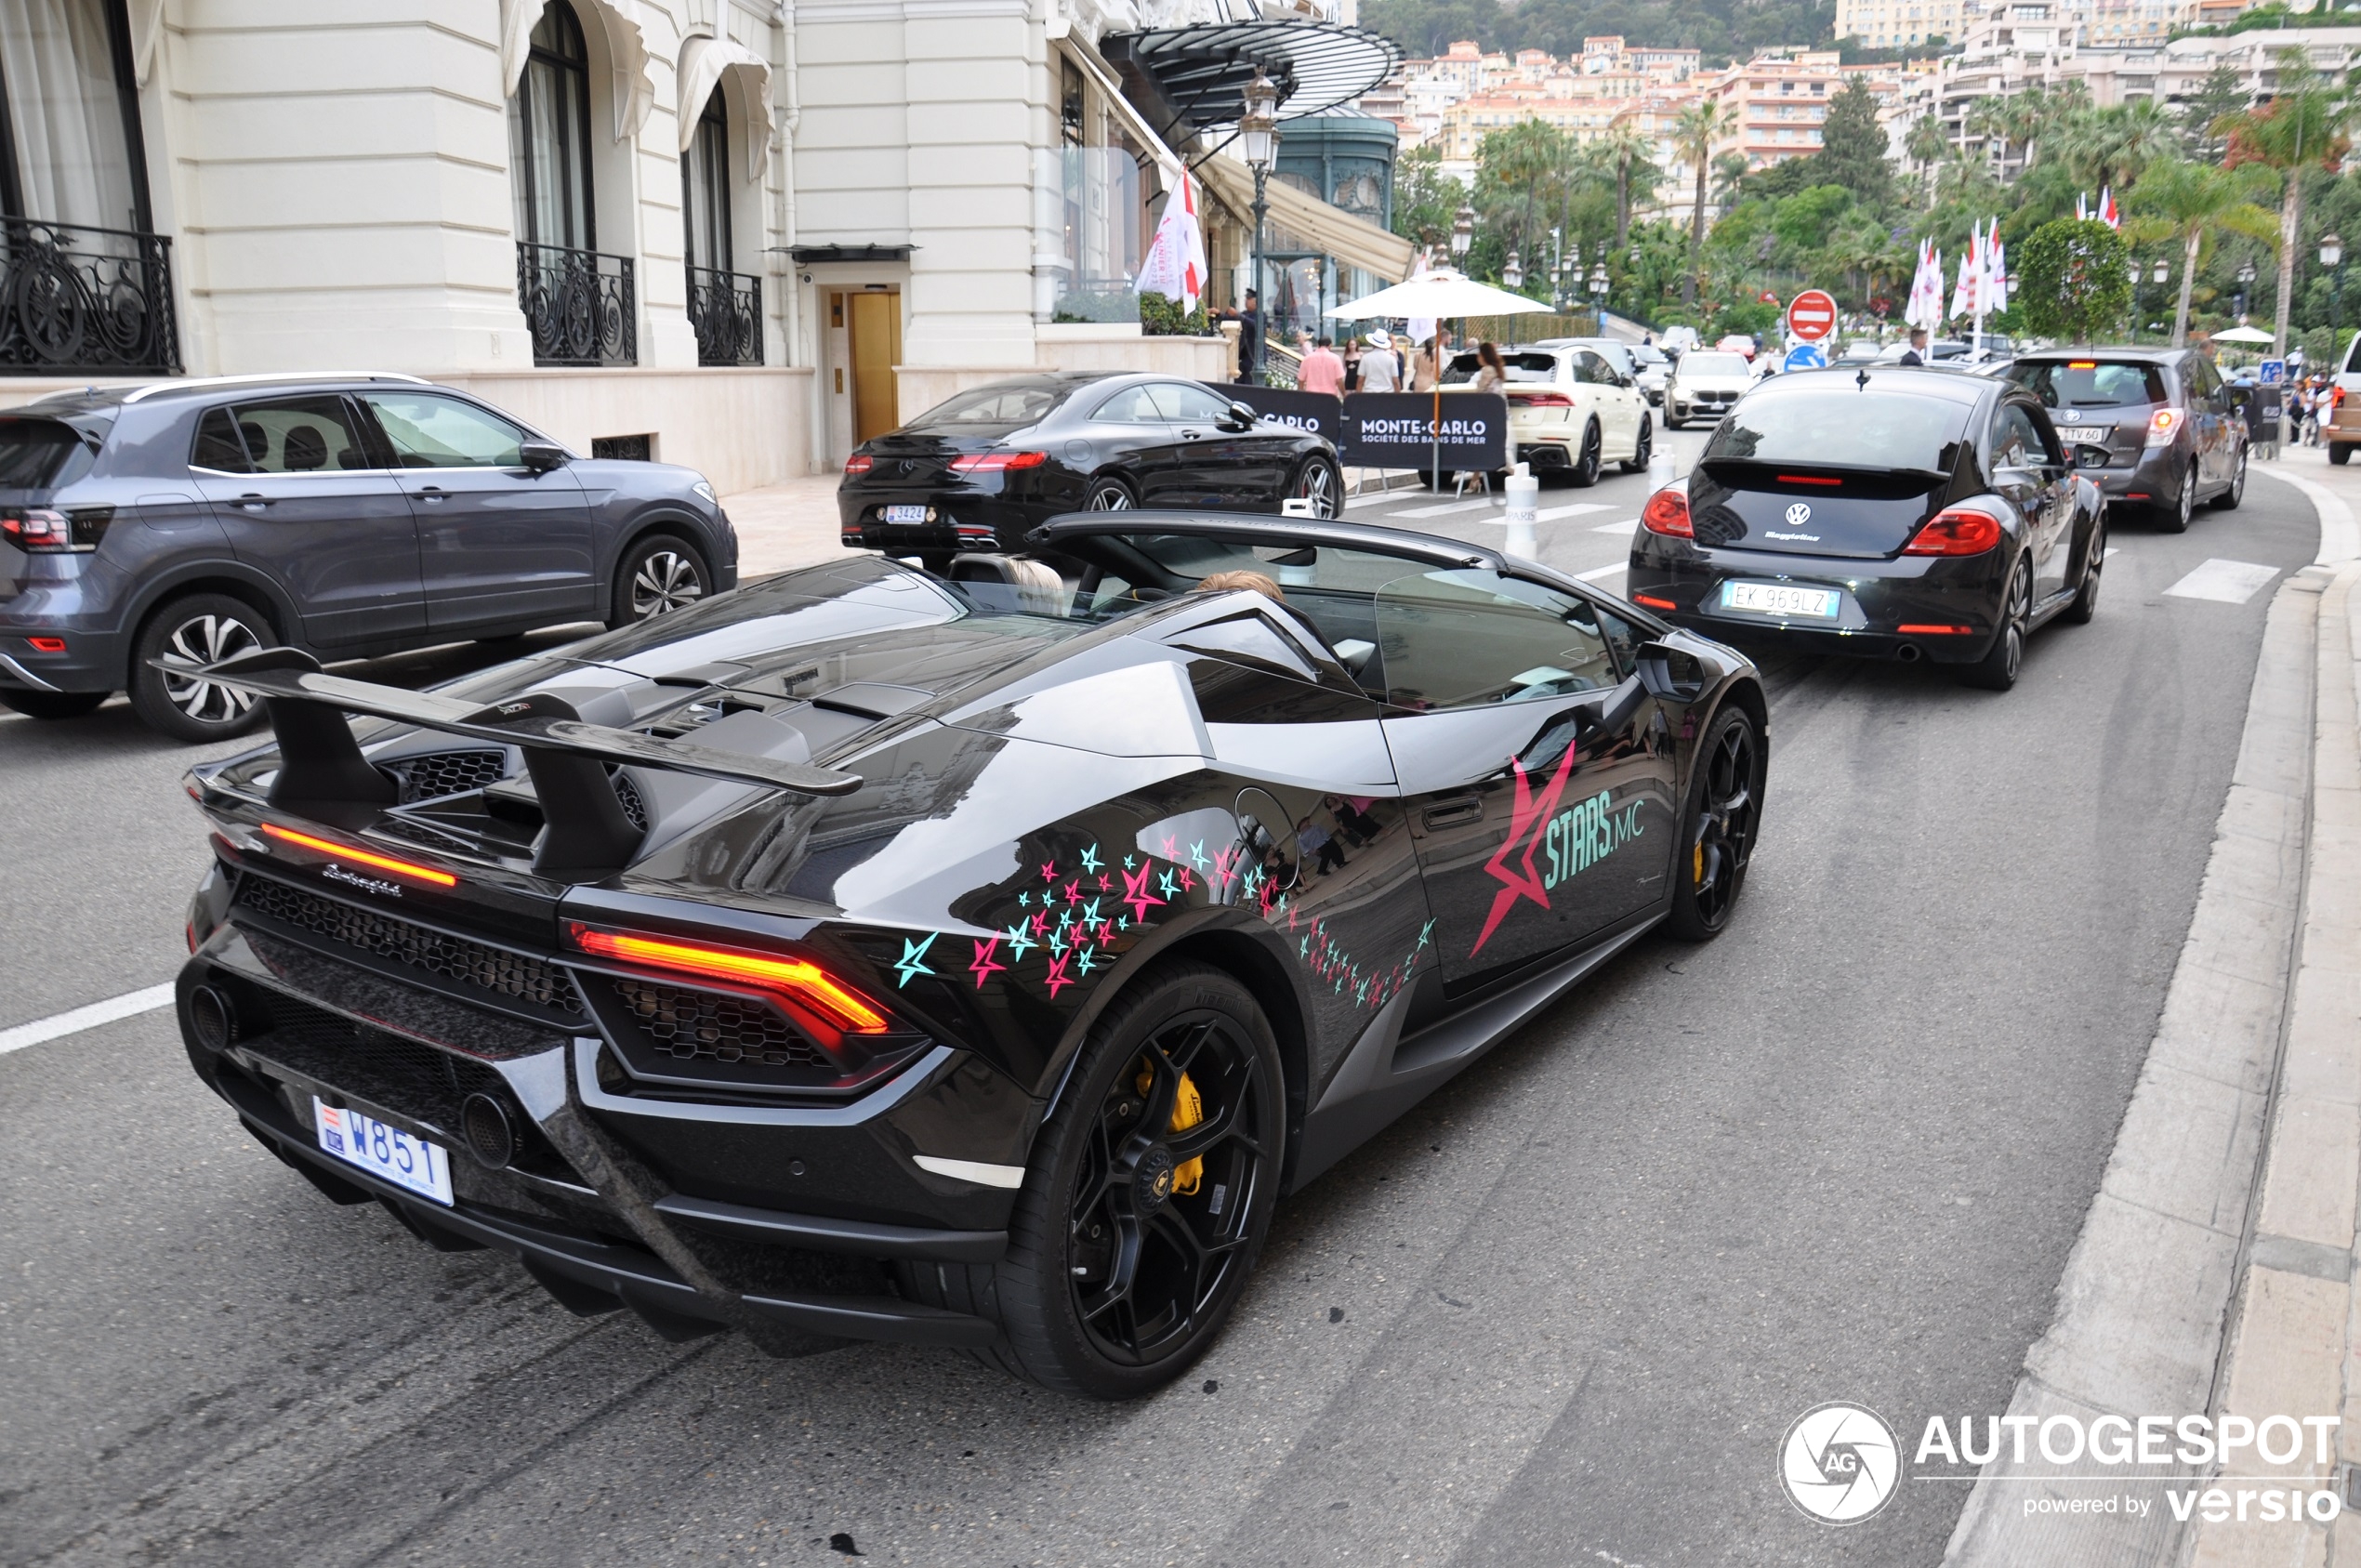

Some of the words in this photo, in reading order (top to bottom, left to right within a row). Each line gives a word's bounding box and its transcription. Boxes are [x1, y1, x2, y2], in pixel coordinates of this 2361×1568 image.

[1361, 434, 1399, 443] SOCIÉTÉ
[1421, 436, 1449, 444] BANS
[1466, 437, 1485, 445] MER
[896, 507, 922, 519] 3424
[1508, 510, 1536, 520] PARIS
[1735, 586, 1758, 606] EK
[1766, 589, 1826, 613] 969LZ
[348, 1110, 435, 1184] W851
